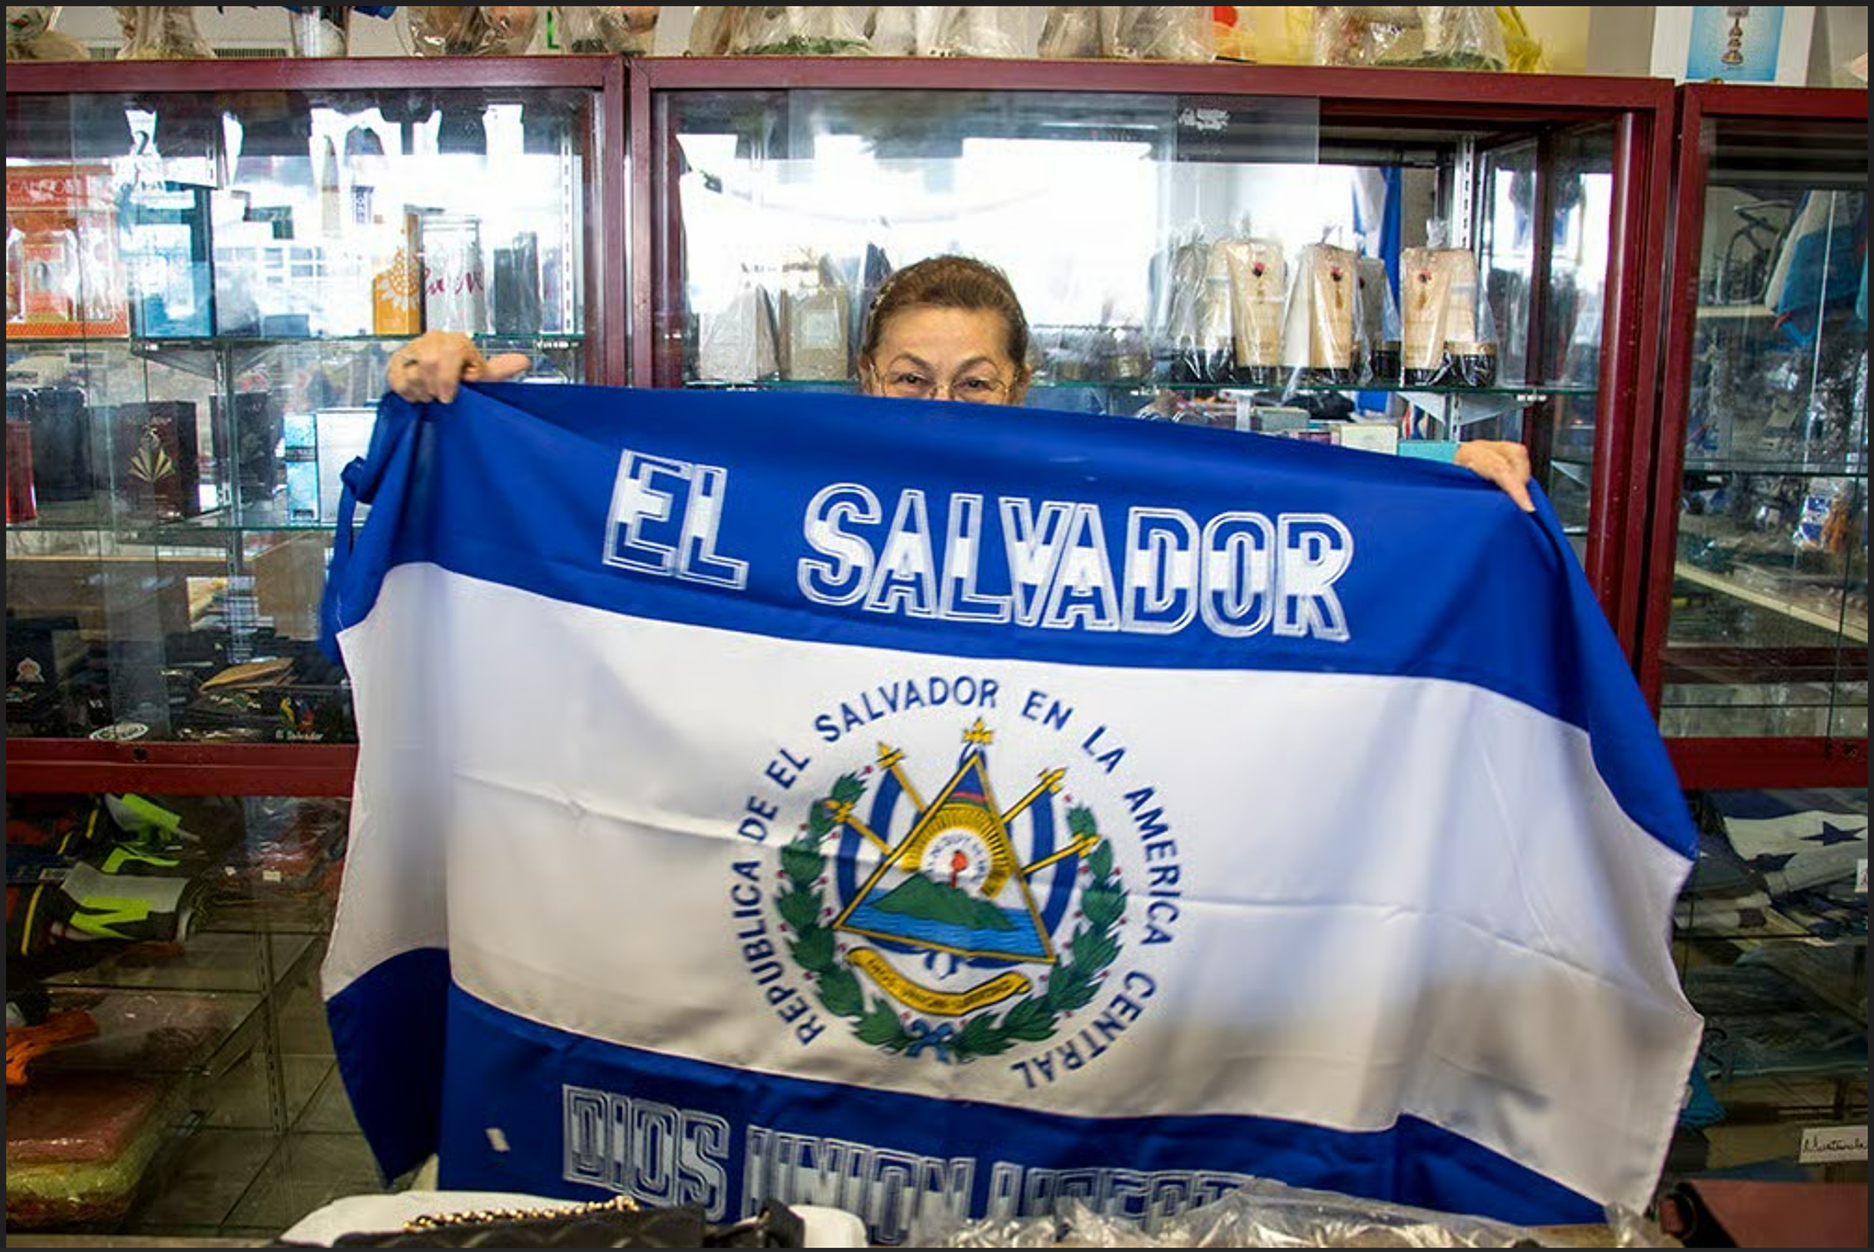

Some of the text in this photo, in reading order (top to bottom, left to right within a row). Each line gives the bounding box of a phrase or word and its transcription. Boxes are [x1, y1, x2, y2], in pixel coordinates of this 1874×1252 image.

[602, 449, 1356, 642] EL SALVADOR
[814, 675, 999, 742] SALVADOR
[1021, 691, 1074, 731] EN
[1081, 725, 1128, 774] LA
[765, 749, 811, 789] EL
[738, 795, 778, 843] DE
[1123, 786, 1181, 946] AMERICA
[731, 860, 826, 1045] REPUBLICA
[1010, 970, 1158, 1089] CENTRAL
[562, 1083, 731, 1223] DIOS
